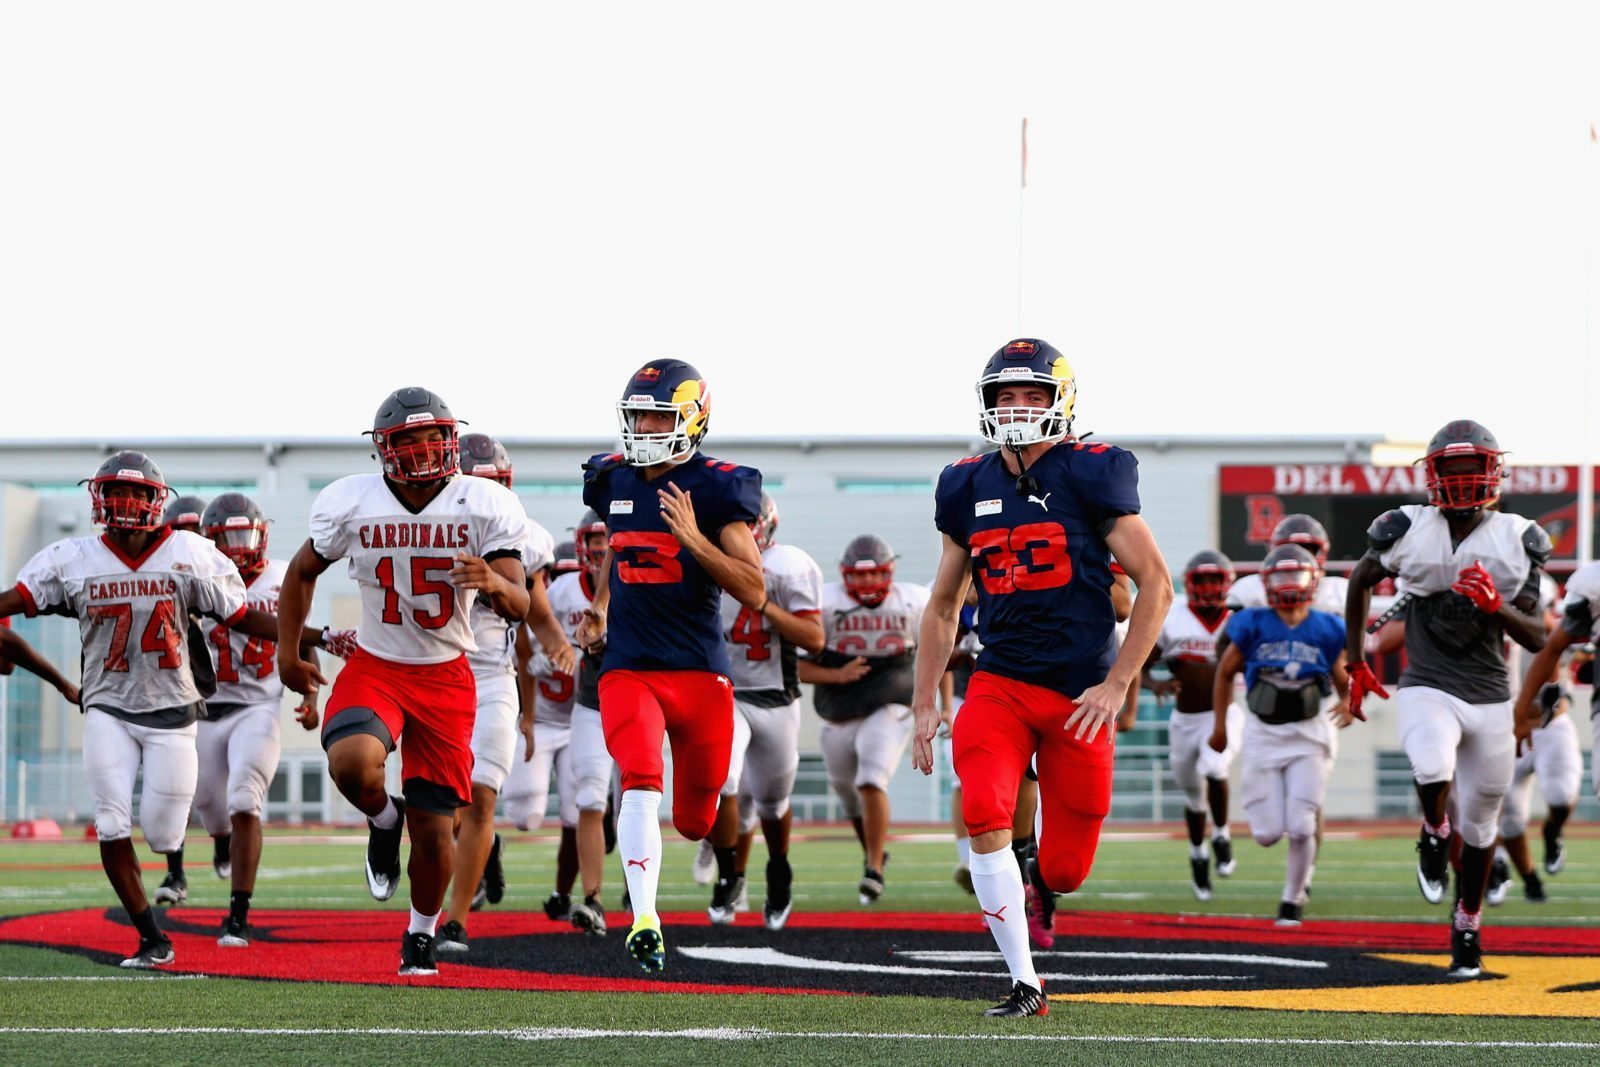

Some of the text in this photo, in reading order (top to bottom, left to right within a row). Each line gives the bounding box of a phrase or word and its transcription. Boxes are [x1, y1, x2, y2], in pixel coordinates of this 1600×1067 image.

[1274, 465, 1355, 495] DEL
[359, 523, 469, 549] CARDINALS
[609, 531, 683, 584] 3
[968, 521, 1073, 595] 33
[89, 579, 177, 600] CARDINALS
[375, 556, 455, 629] 15
[86, 599, 182, 673] 74
[209, 623, 276, 683] 14
